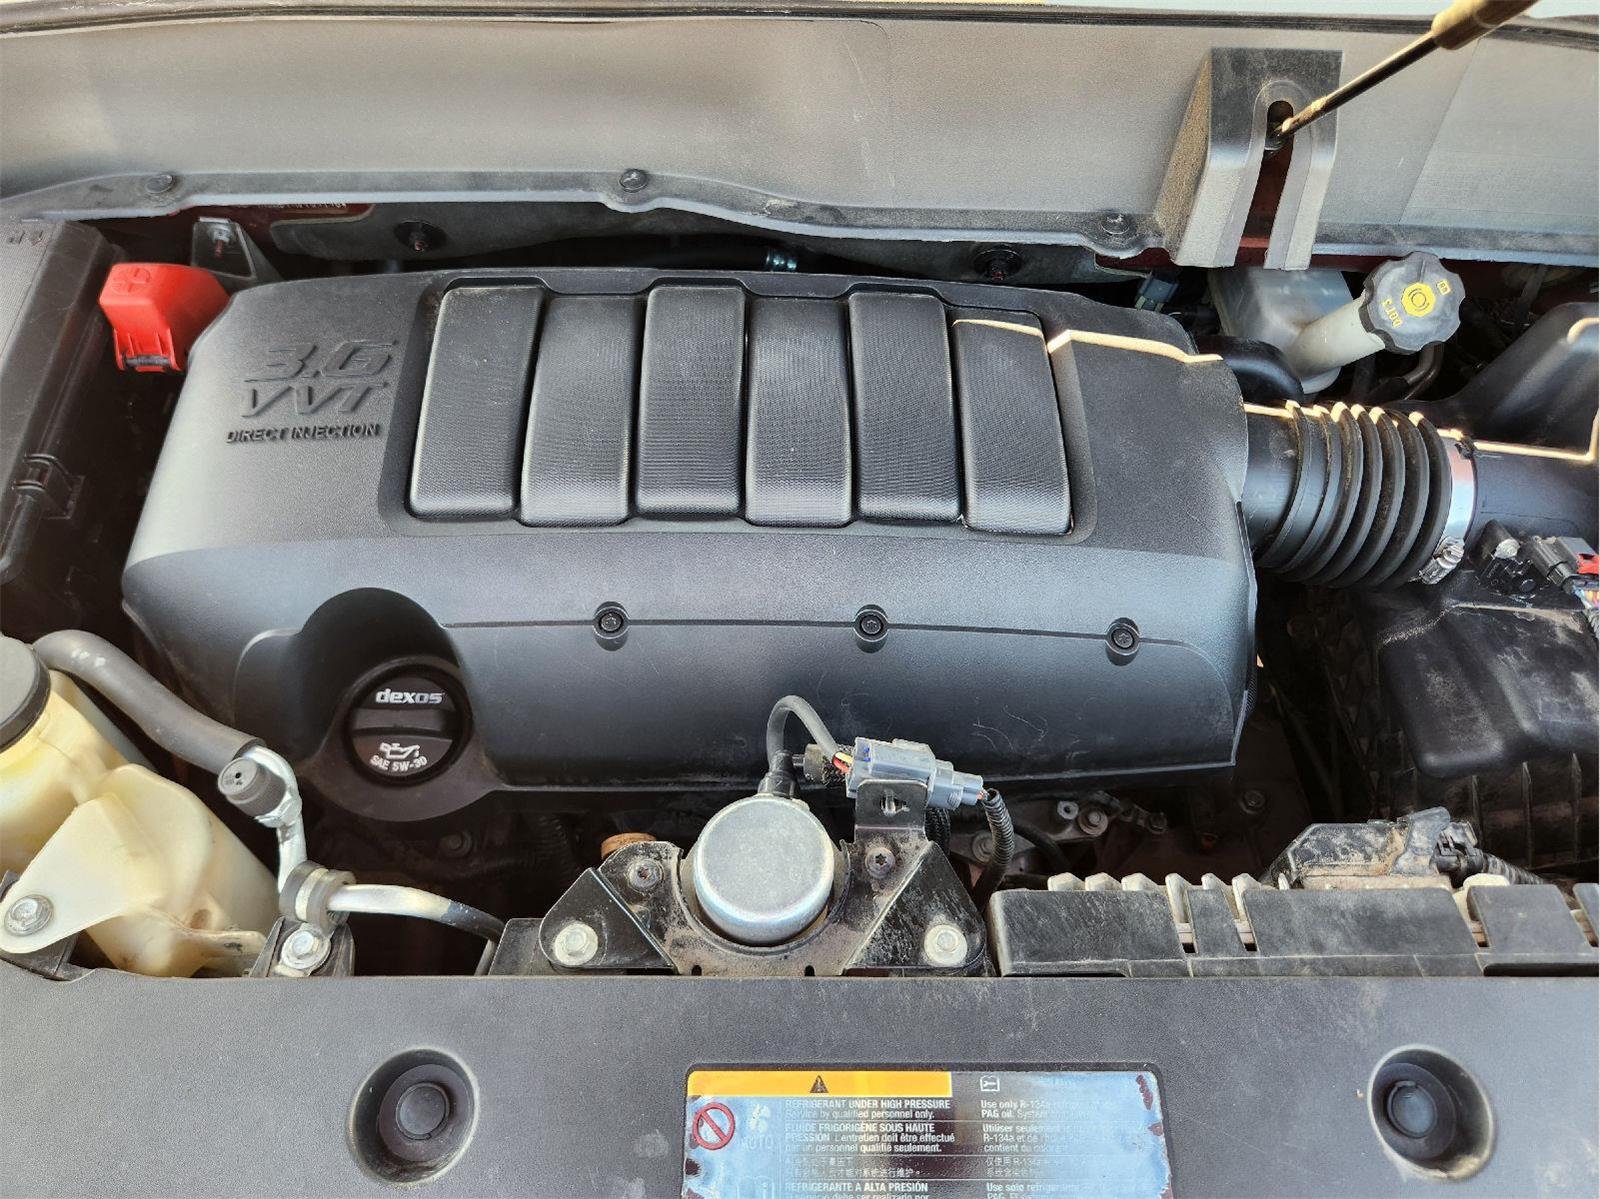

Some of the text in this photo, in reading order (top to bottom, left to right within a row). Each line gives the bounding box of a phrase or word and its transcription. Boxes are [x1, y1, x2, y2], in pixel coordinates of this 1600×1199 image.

[243, 339, 396, 382] 3.6
[242, 381, 390, 418] VVT
[226, 423, 381, 443] DIRECT INJECTION
[375, 688, 443, 704] dexos
[370, 755, 428, 772] SAE 5W-30
[848, 1099, 878, 1109] UNDER
[880, 1099, 902, 1109] HIGH
[904, 1099, 951, 1109] PRESSURE
[981, 1099, 997, 1109] Use
[999, 1099, 1018, 1111] only
[871, 1110, 913, 1120] personnel
[915, 1109, 935, 1120] only.
[981, 1109, 1000, 1118] PAG
[879, 1123, 904, 1132] SOUS
[905, 1123, 935, 1132] HAUTE
[983, 1123, 1013, 1133] Utiliser
[881, 1133, 898, 1142] doit
[919, 1133, 955, 1142] effectué
[860, 1142, 893, 1153] qualifié
[894, 1143, 942, 1152] seulement.
[854, 1182, 863, 1192] A
[864, 1182, 887, 1192] ALTA
[888, 1181, 928, 1192] PRESIÓN
[986, 1182, 1003, 1192] Use
